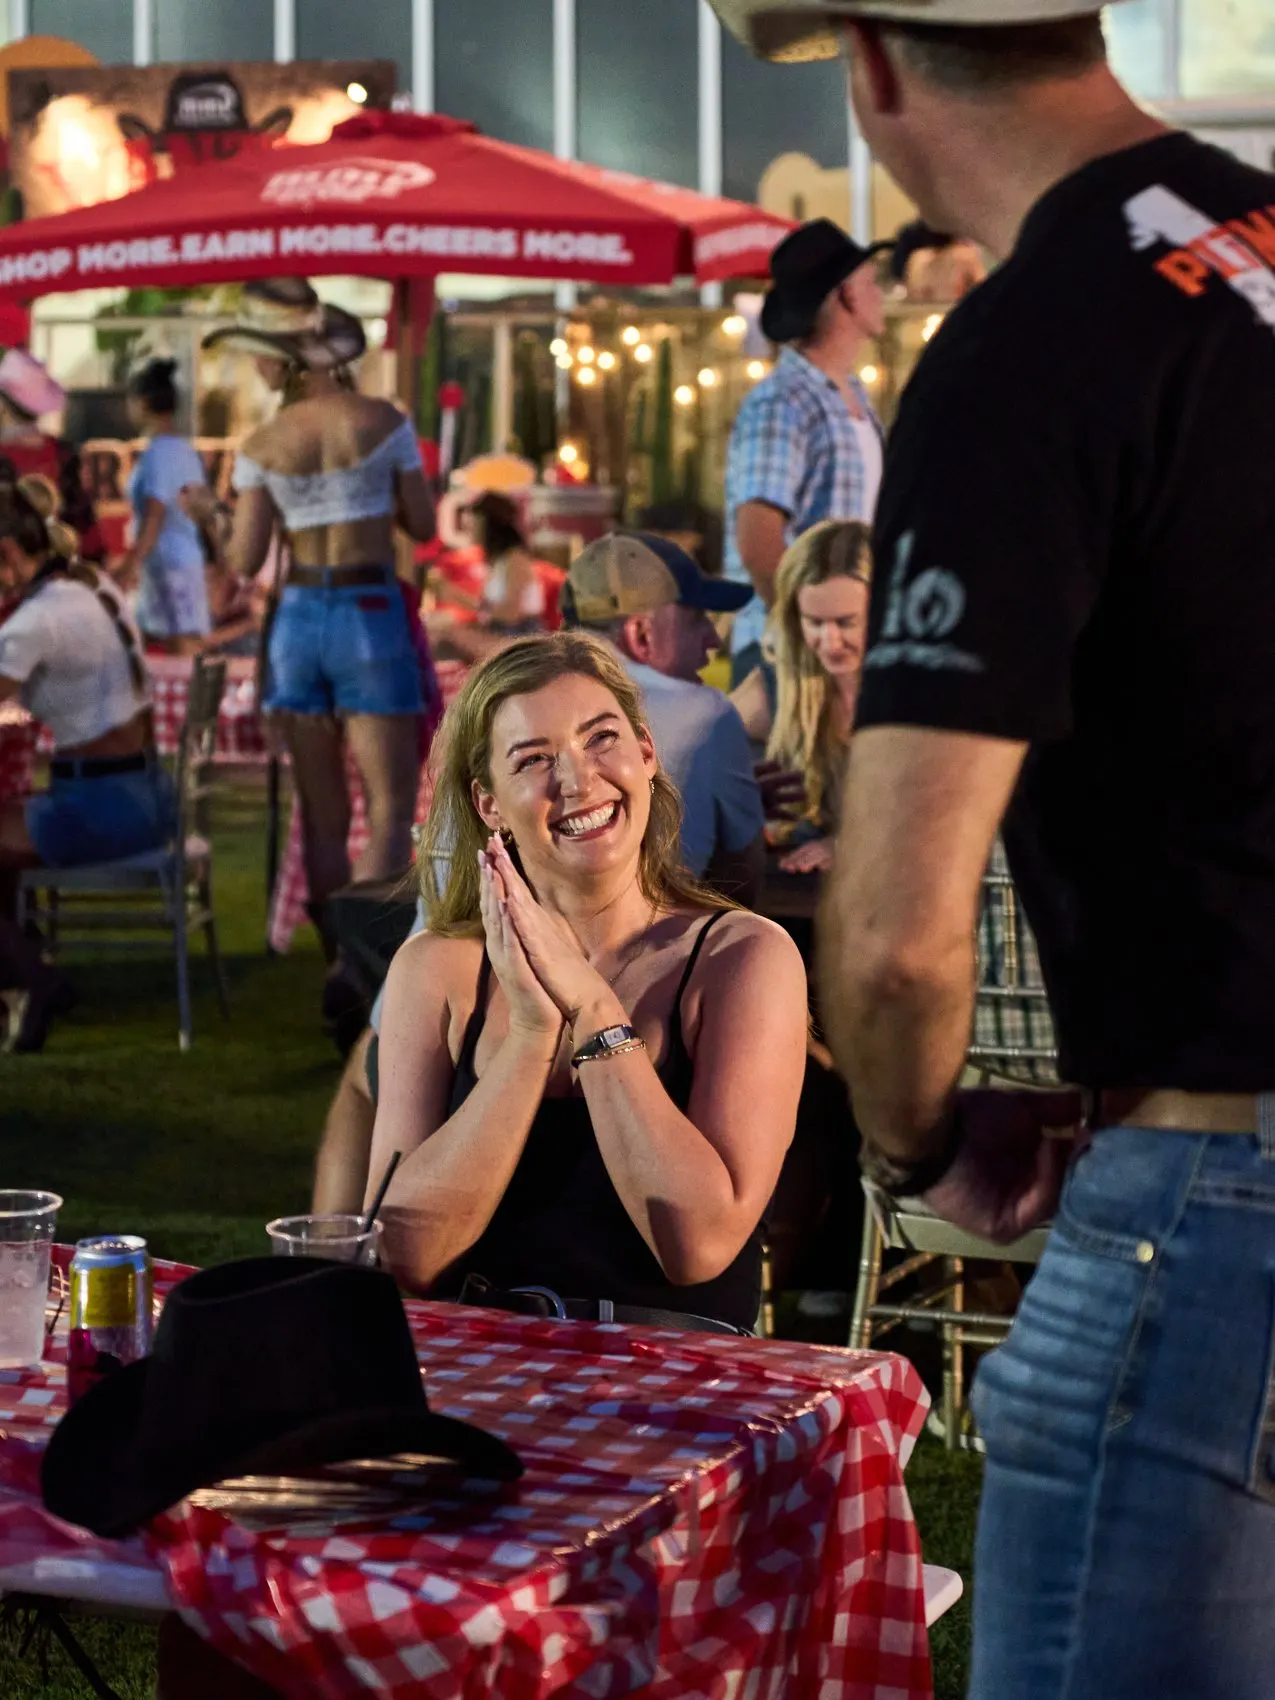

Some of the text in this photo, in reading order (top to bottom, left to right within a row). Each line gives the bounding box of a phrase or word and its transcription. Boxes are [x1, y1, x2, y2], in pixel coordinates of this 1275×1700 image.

[0, 223, 634, 286] HOP MORE. EARN MORE. CHEERS MORE.
